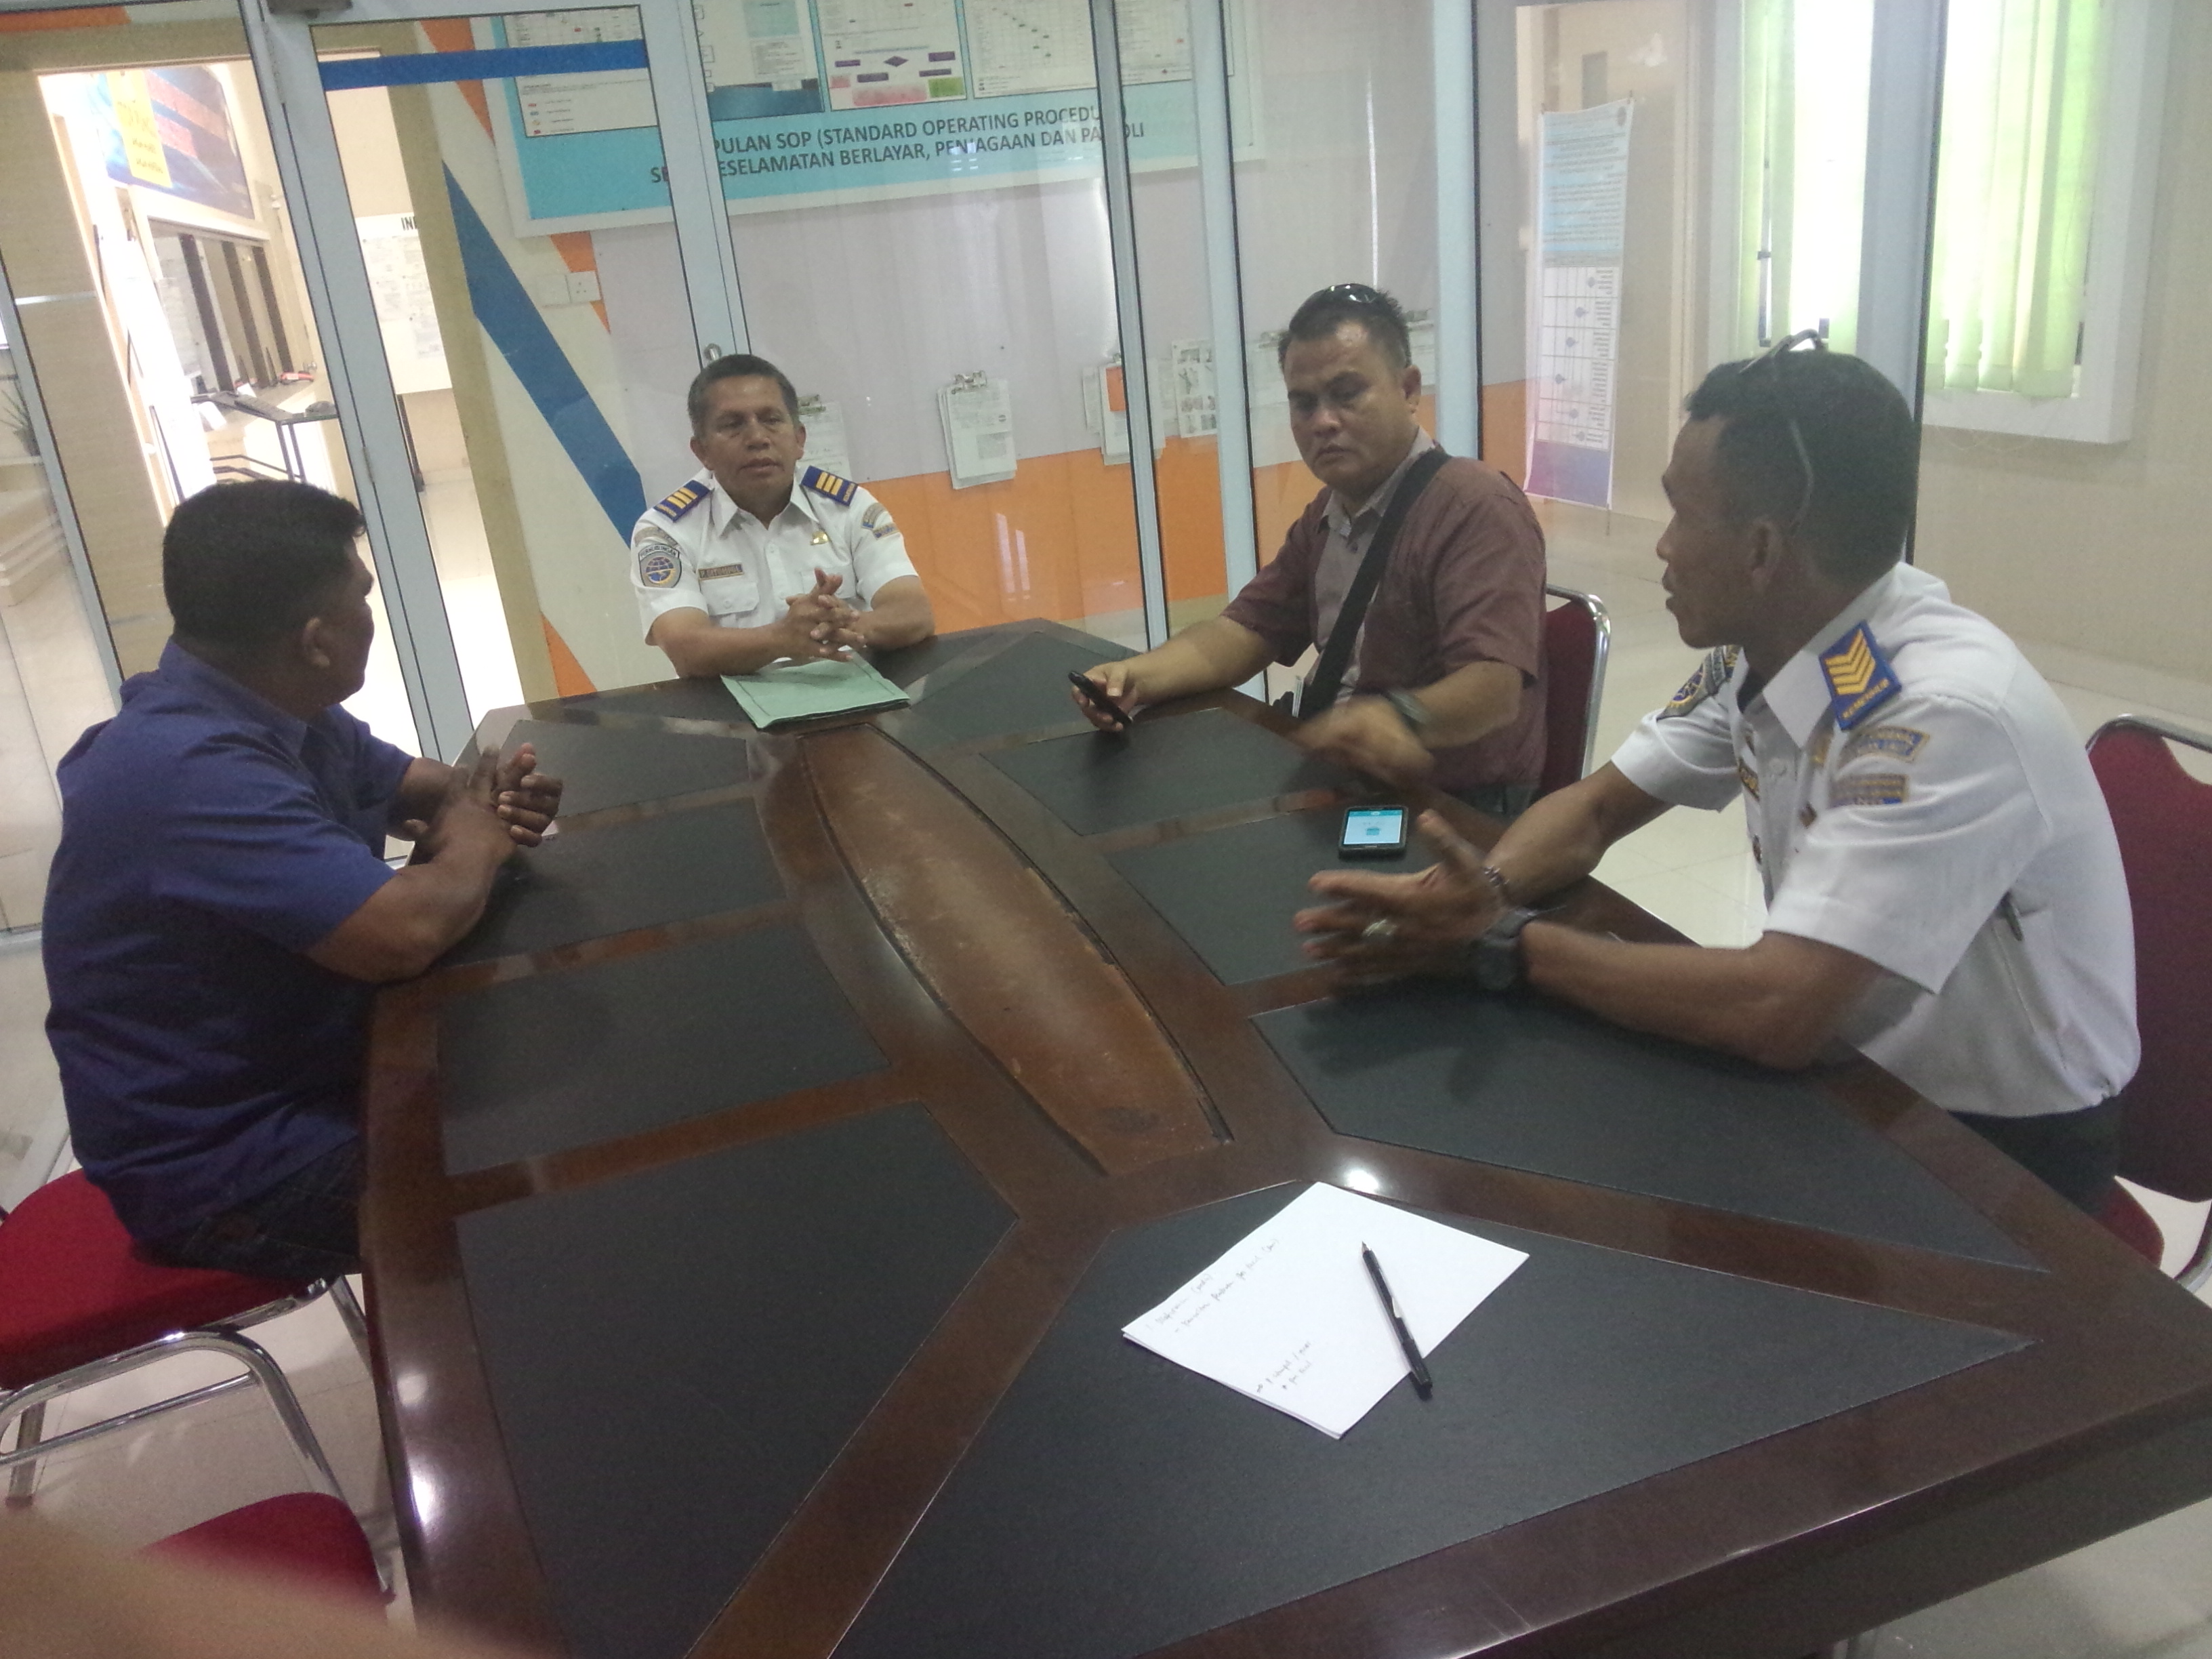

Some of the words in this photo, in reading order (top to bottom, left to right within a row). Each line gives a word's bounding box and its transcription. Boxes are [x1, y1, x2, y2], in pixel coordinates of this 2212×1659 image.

[775, 131, 812, 150] SOP
[817, 121, 918, 149] (STANDARD
[922, 112, 1019, 137] OPERATING
[718, 150, 835, 178] ESELAMATAN
[840, 143, 930, 167] BERLAYAR,
[1041, 129, 1077, 146] DAN
